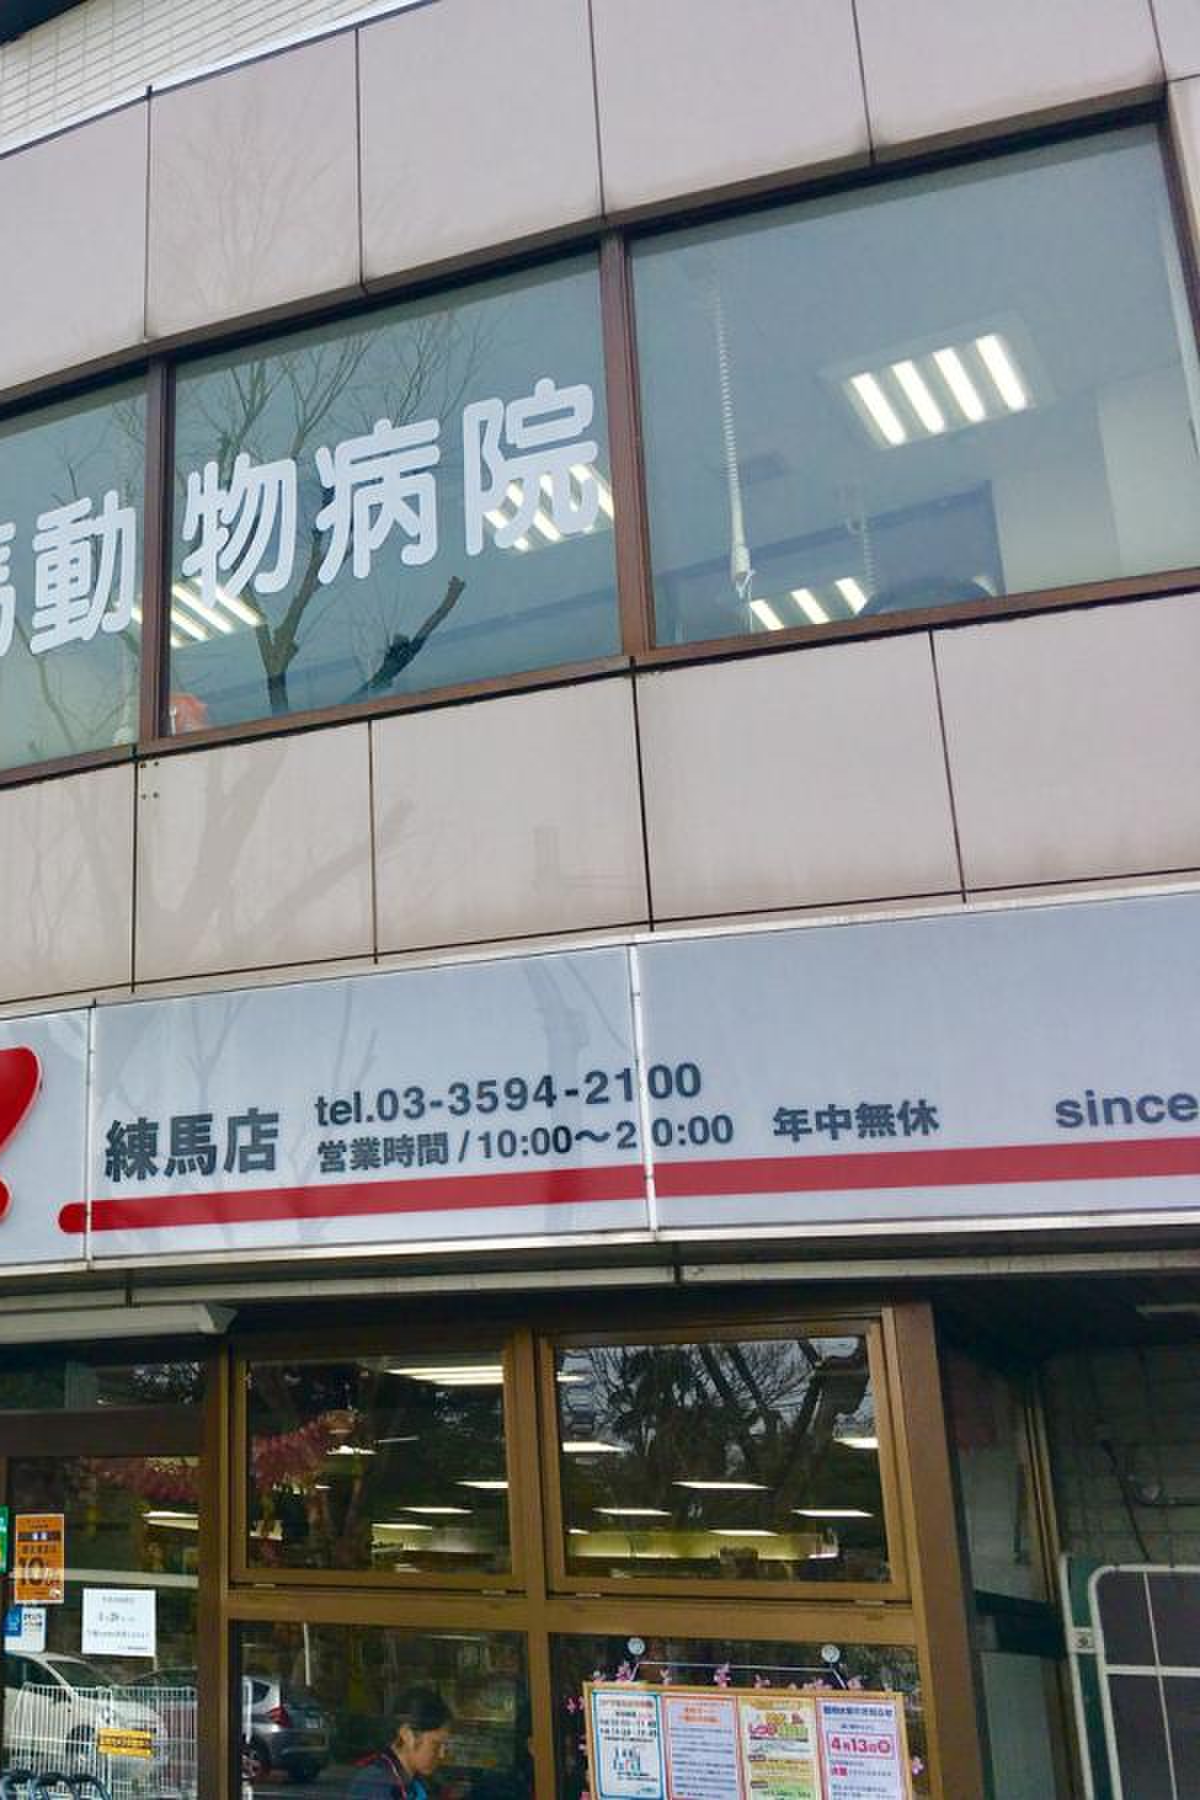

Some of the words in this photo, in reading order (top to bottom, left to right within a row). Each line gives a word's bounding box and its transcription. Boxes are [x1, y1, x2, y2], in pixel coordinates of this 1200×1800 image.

[315, 1062, 702, 1127] tel.03-3594-2100
[773, 1099, 940, 1142] 年中無休
[1055, 1089, 1200, 1128] since
[104, 1106, 280, 1183] 練馬店
